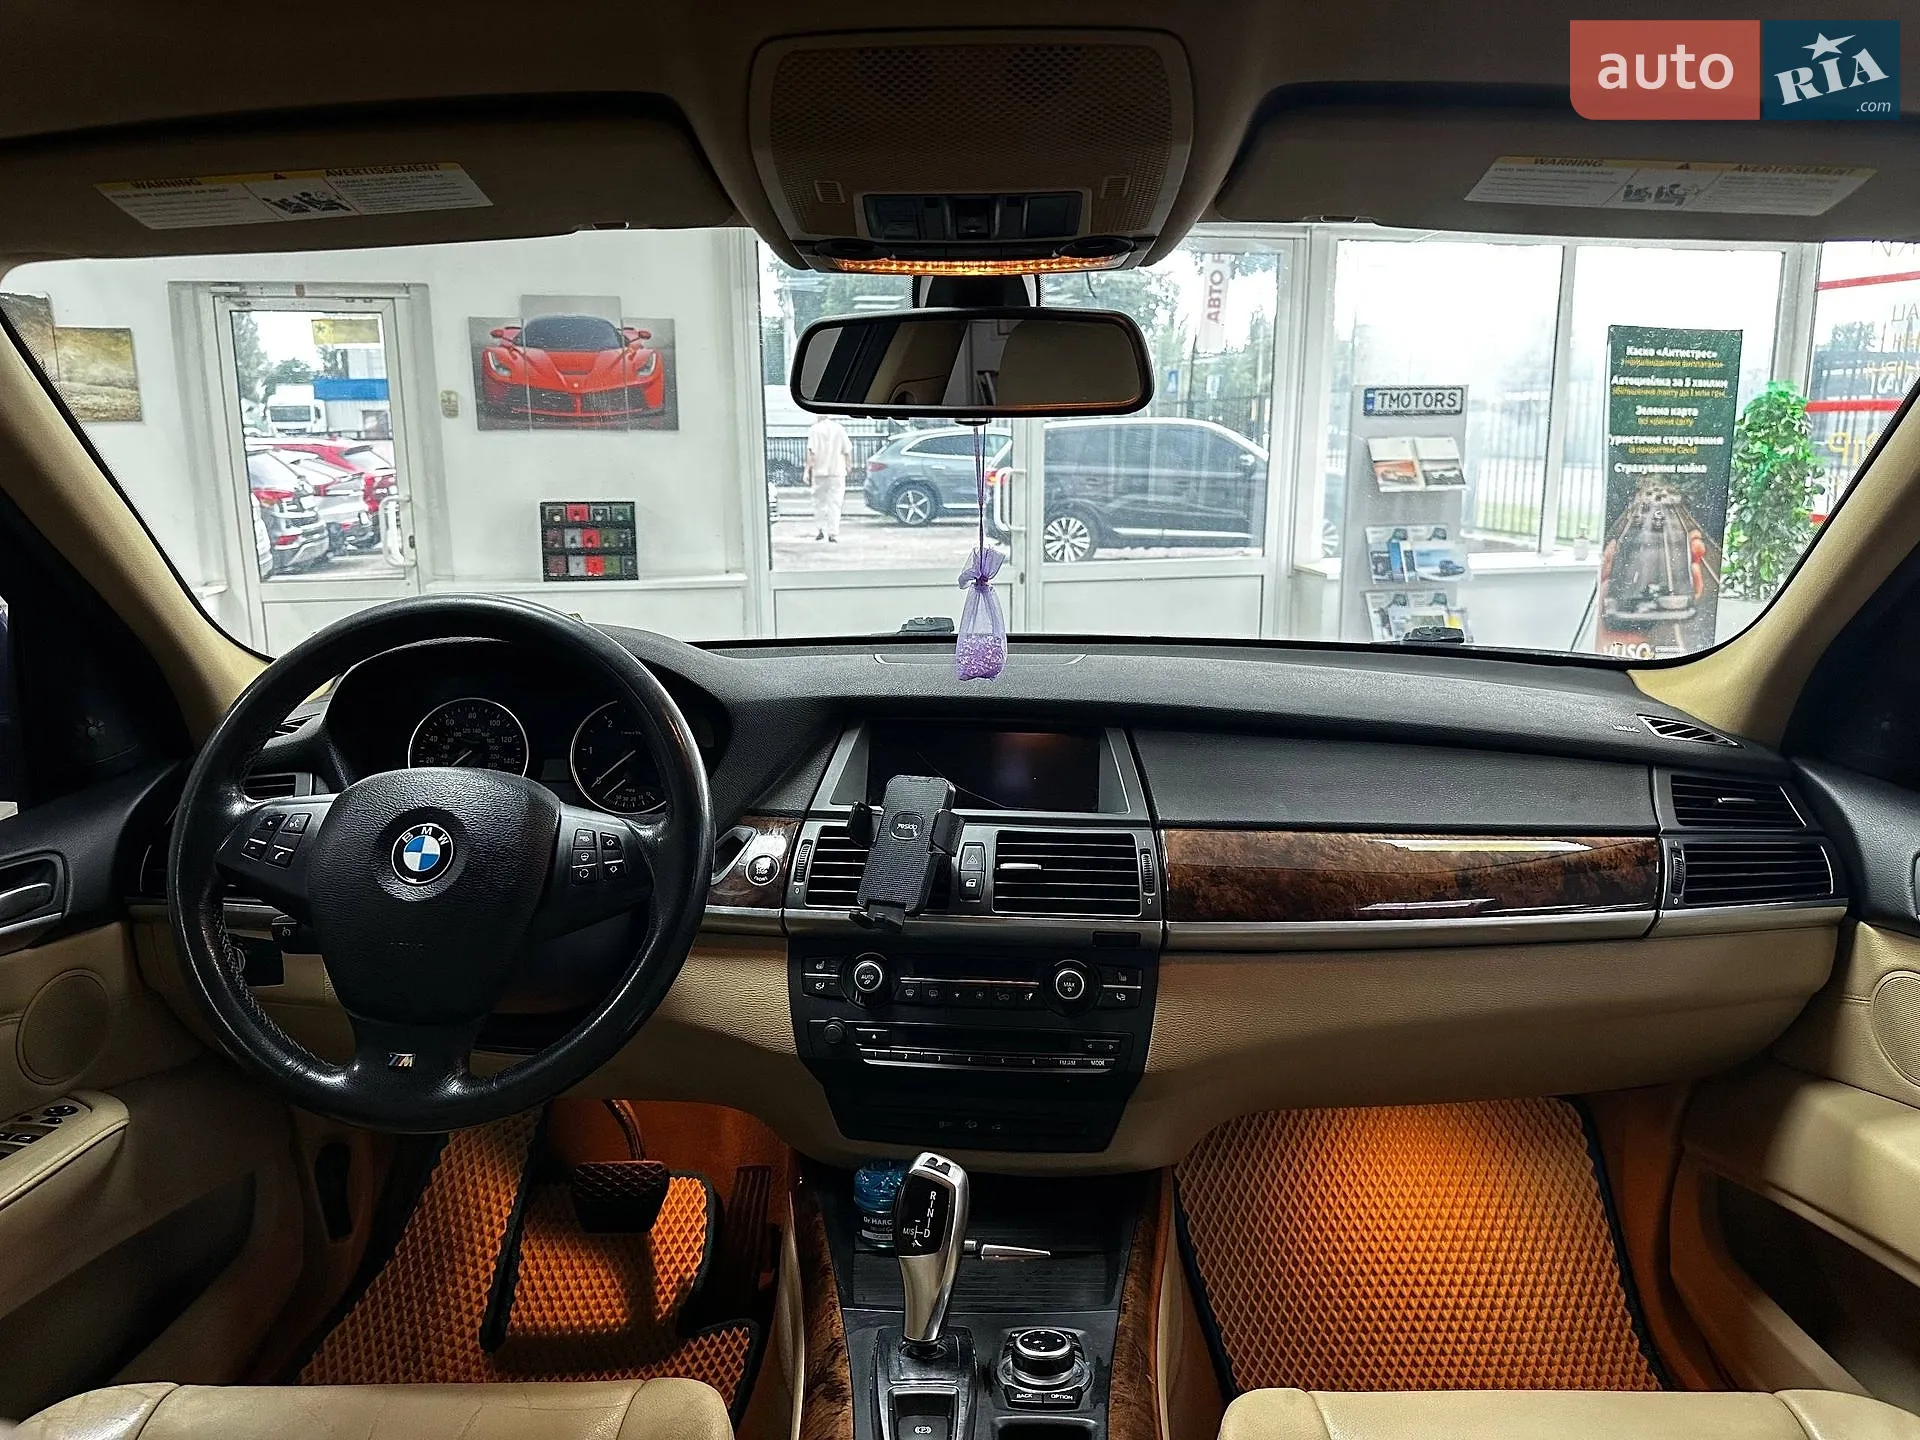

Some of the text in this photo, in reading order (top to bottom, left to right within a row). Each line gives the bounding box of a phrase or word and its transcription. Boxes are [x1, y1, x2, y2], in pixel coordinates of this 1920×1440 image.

[1533, 158, 1854, 176] WARNING AVERTISSEMENT
[130, 162, 442, 189] WARNING AVERTISSEMENT
[1378, 392, 1457, 408] TMOTORS
[1614, 463, 1676, 474] Страхування
[608, 720, 613, 728] 2
[402, 827, 449, 846] BMW
[930, 1191, 936, 1200] R
[927, 1208, 934, 1217] N
[923, 1228, 930, 1238] D
